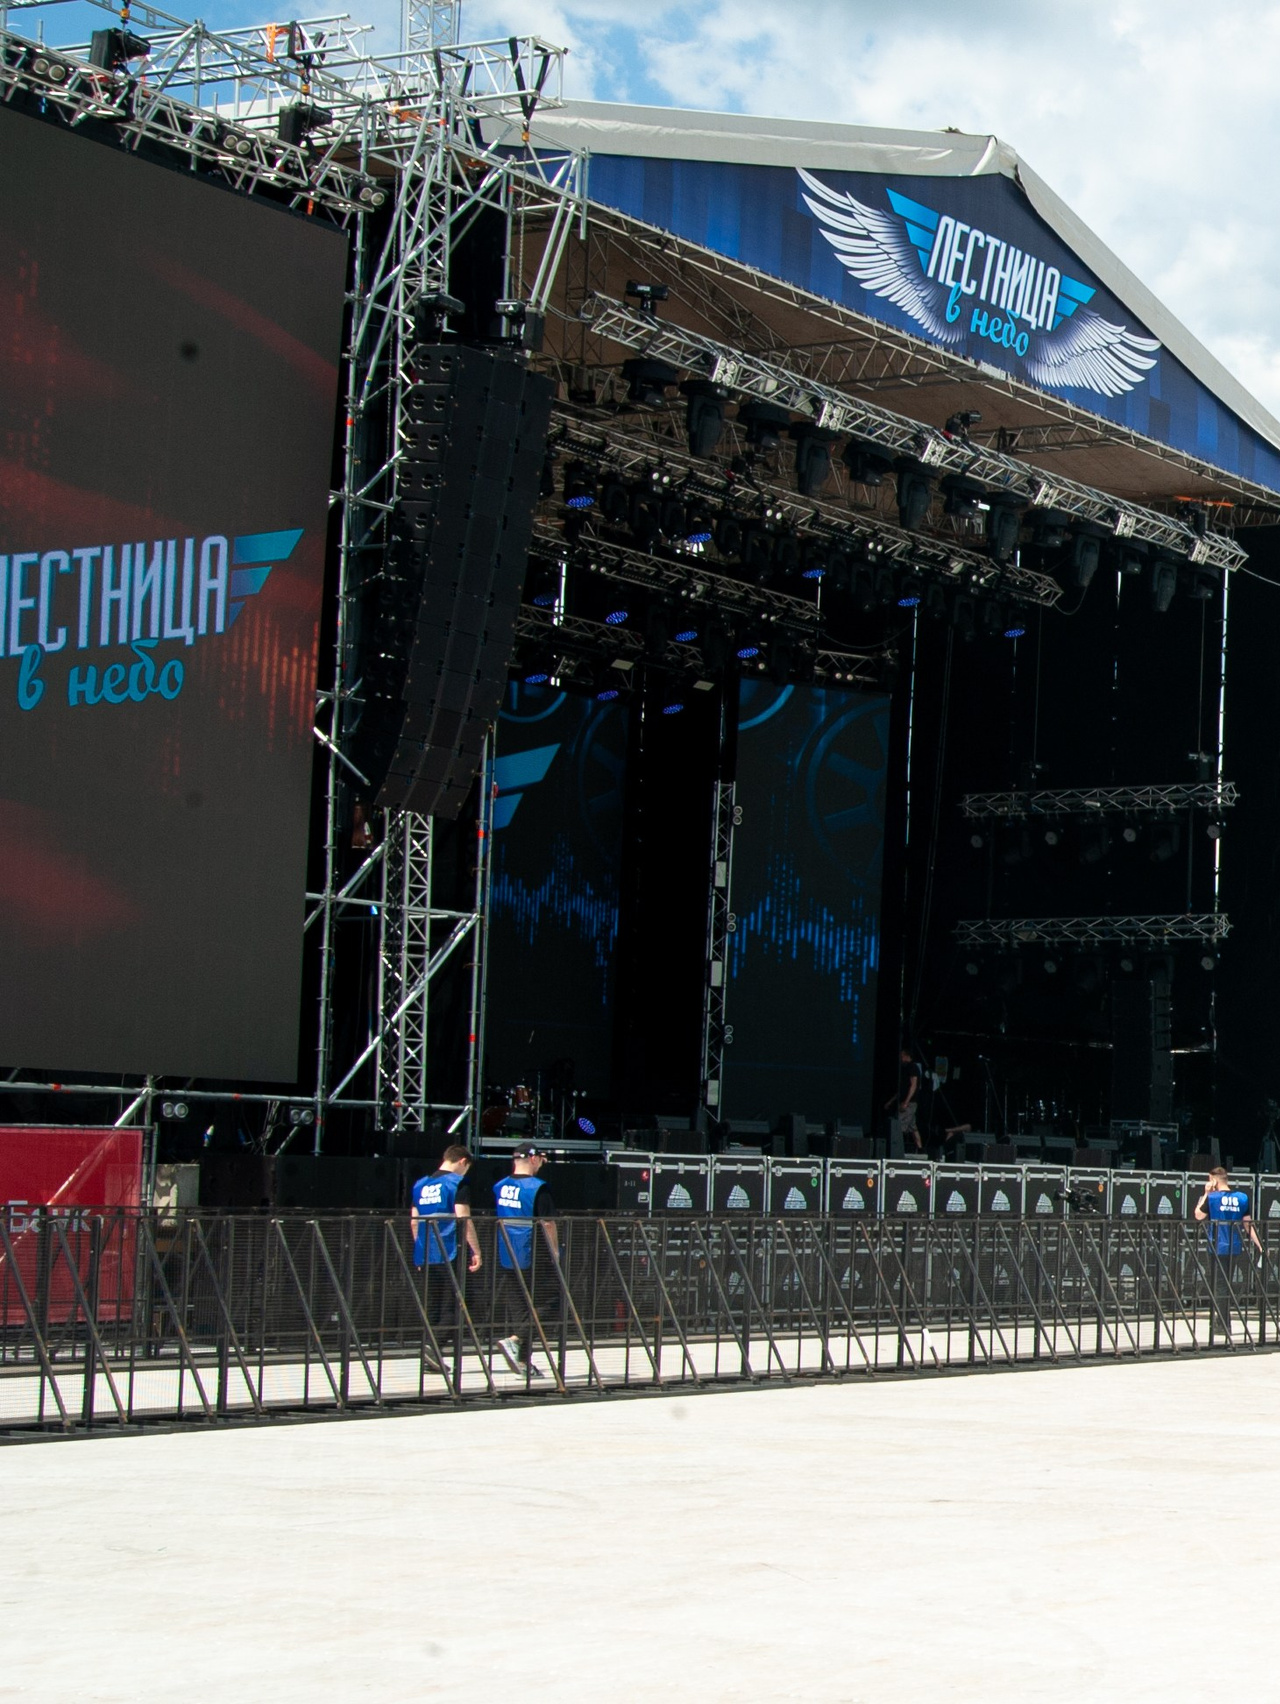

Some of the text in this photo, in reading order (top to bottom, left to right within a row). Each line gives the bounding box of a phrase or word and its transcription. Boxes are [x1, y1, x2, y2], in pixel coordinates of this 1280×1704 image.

[927, 215, 1060, 331] ЛЕСТНИЦА
[945, 282, 1030, 356] в небо
[17, 638, 186, 711] в небо
